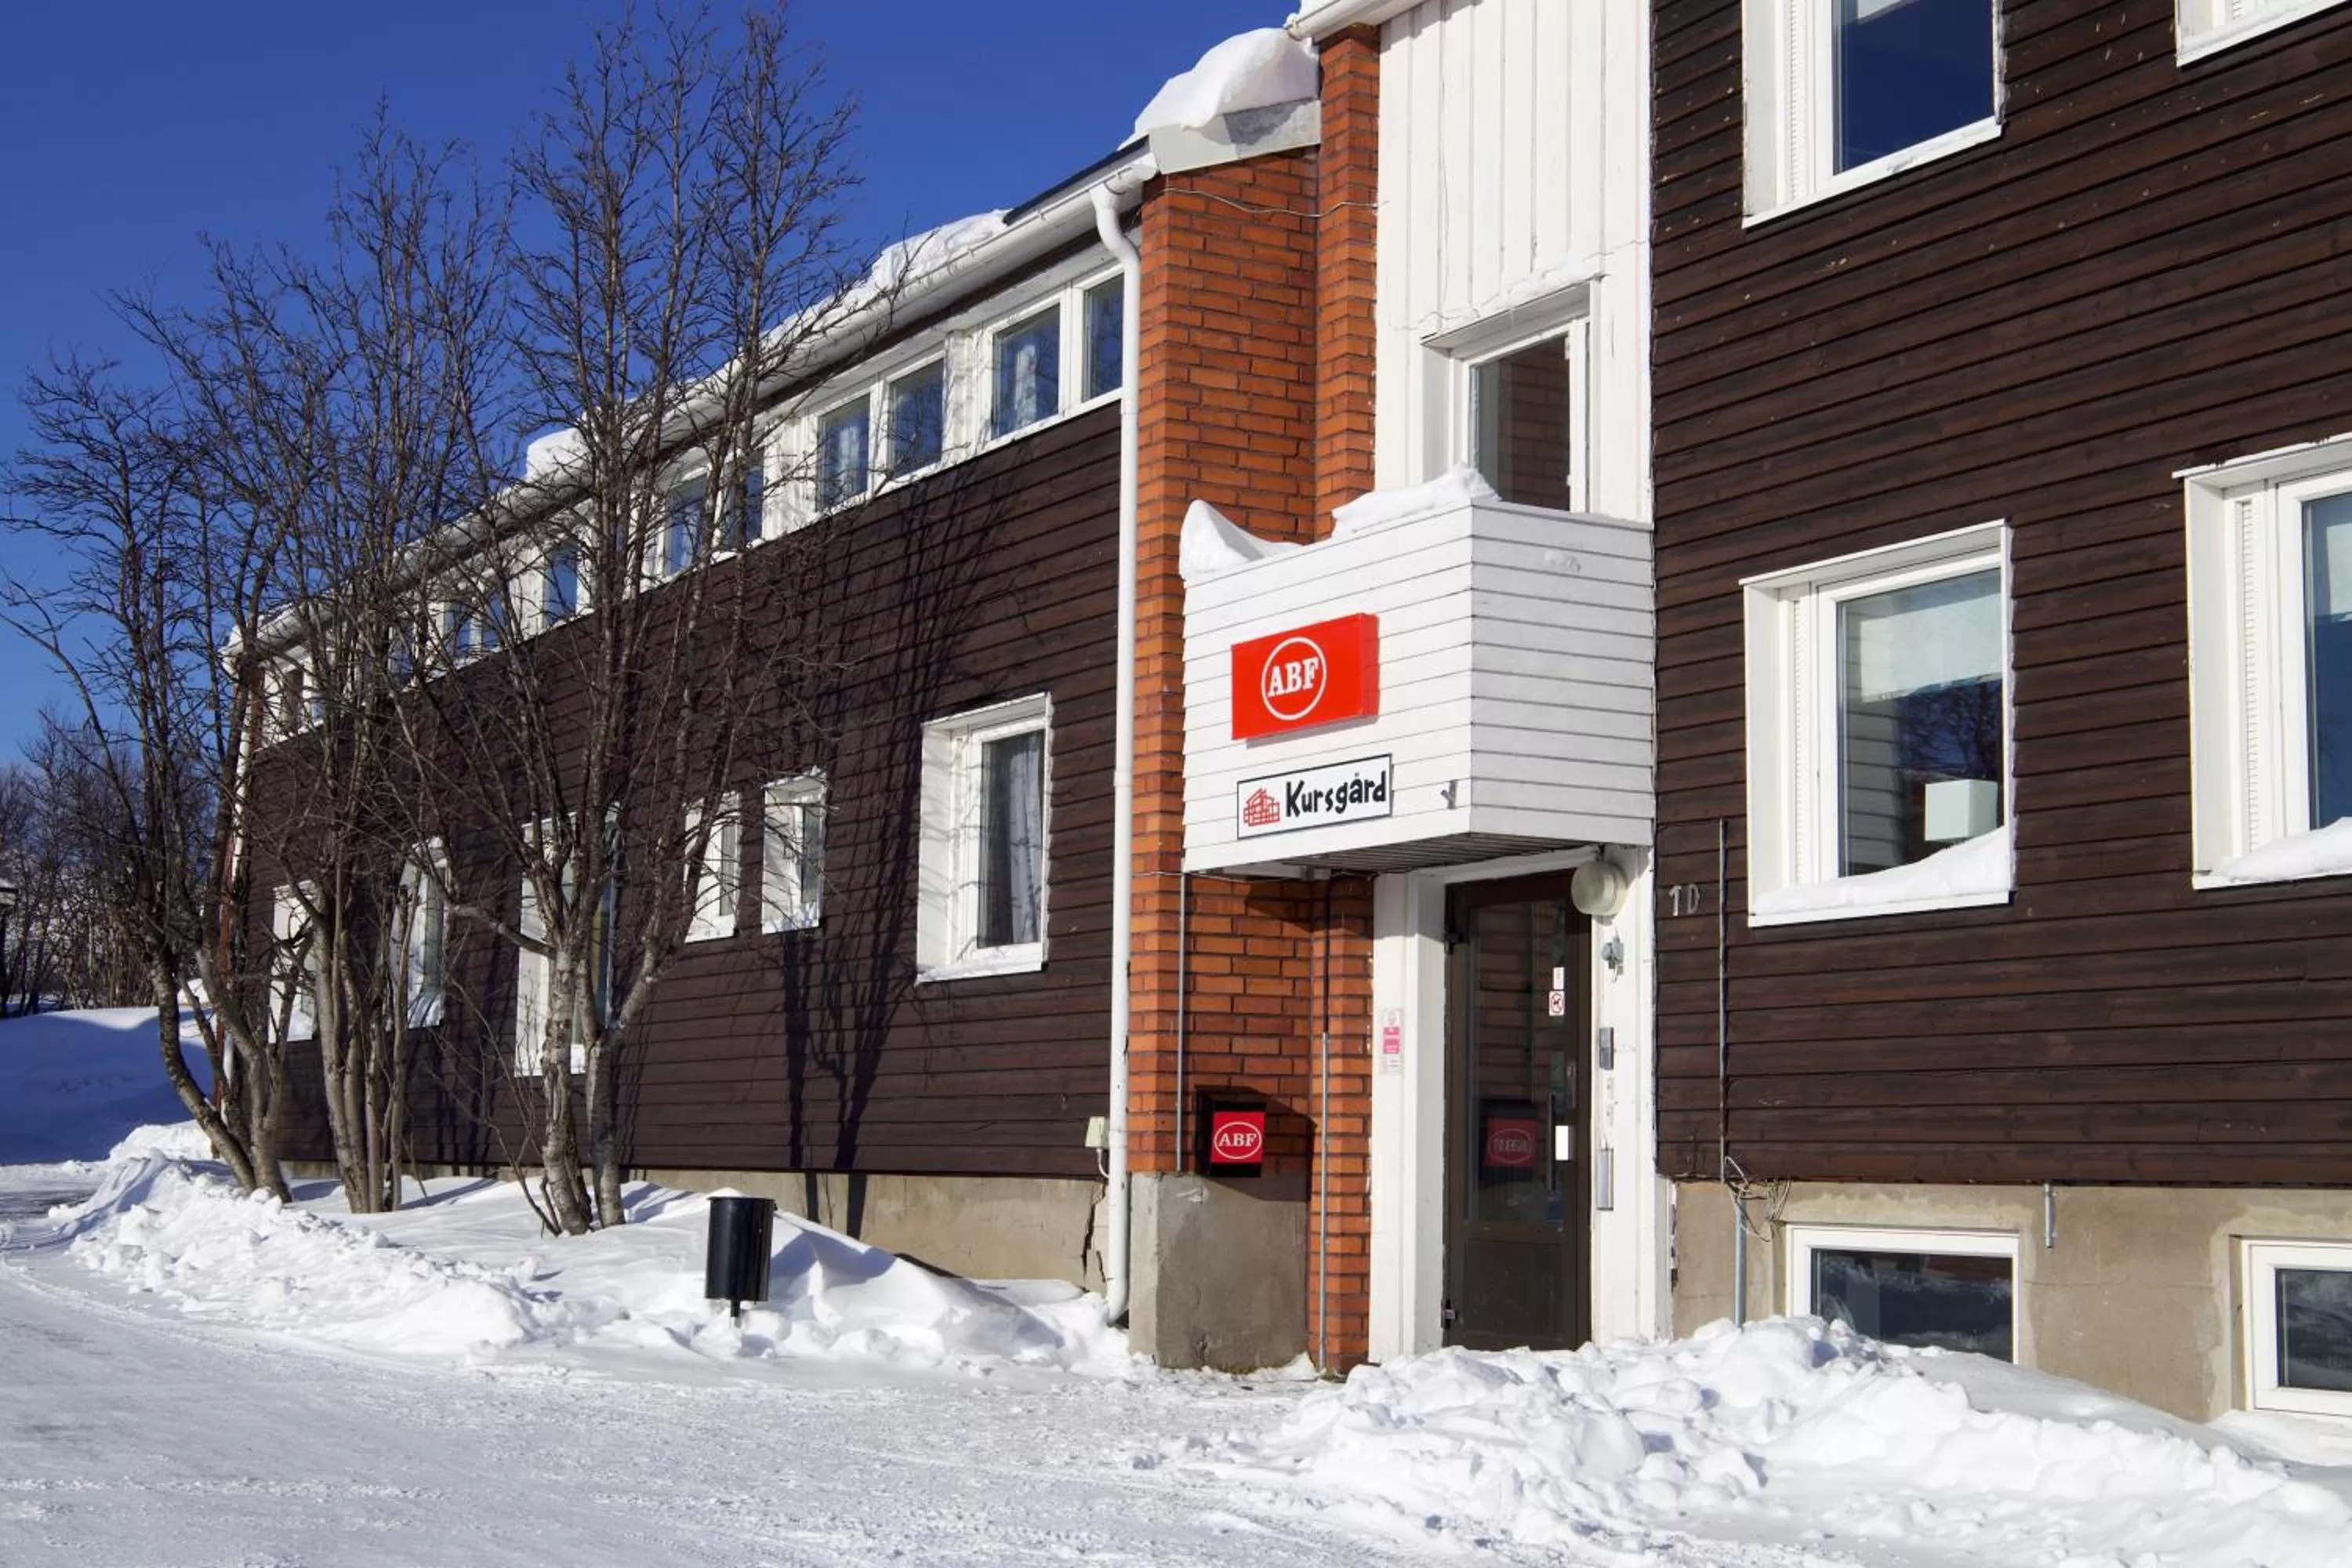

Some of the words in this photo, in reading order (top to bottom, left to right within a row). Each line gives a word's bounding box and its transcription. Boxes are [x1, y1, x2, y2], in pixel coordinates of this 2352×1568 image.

[1267, 656, 1319, 697] ABF
[1286, 770, 1386, 817] Kursgård
[1218, 1133, 1256, 1147] ABF
